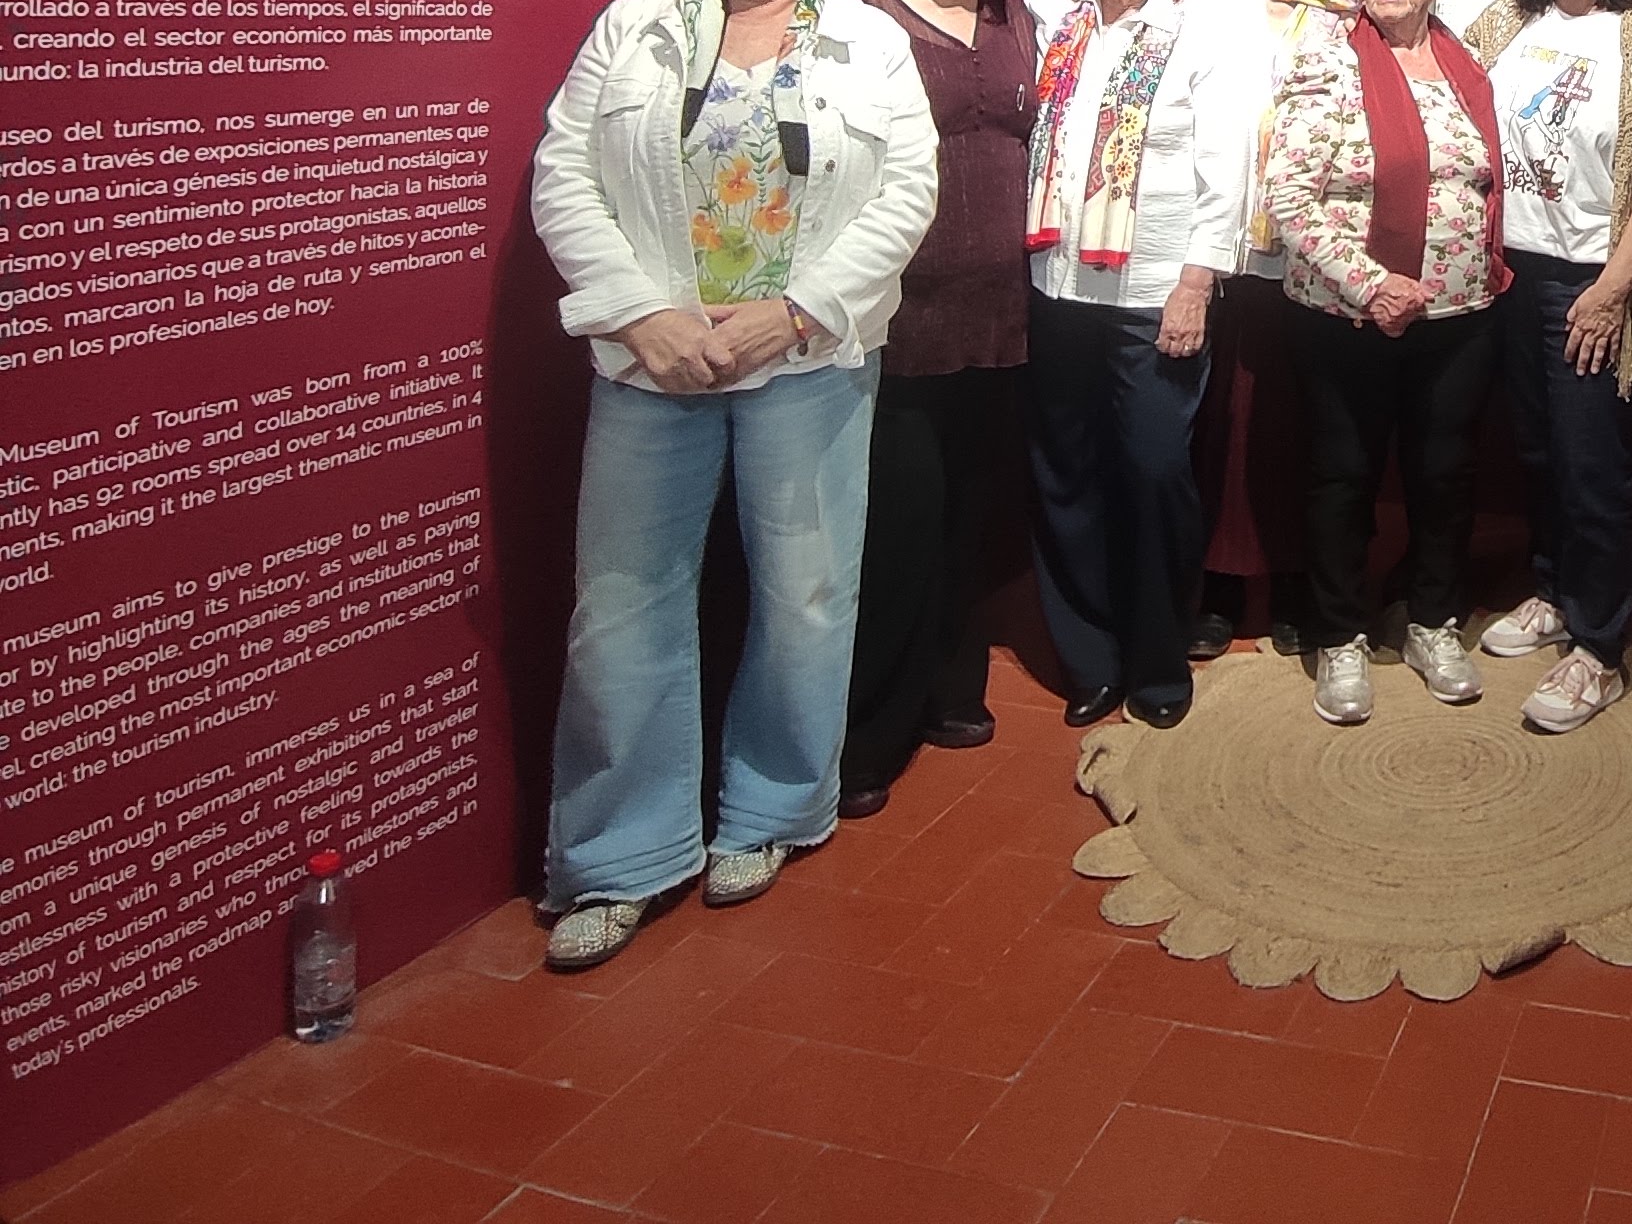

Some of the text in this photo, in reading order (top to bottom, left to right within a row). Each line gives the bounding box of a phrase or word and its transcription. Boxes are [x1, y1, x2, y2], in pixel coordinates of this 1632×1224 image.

[14, 26, 492, 49] creando el sector económico más importante
[19, 221, 64, 240] con
[74, 216, 104, 234] un
[113, 199, 244, 229] sentimiento
[252, 188, 344, 216] protector
[351, 181, 399, 200] hacia
[406, 178, 421, 194] la
[428, 171, 487, 191] historia
[33, 346, 62, 364] en
[70, 339, 104, 357] los
[110, 310, 258, 355] profesionales
[263, 303, 290, 321] de
[295, 297, 334, 316] hoy.
[0, 339, 483, 466] Museum of Tourism was born from a 100%
[3, 488, 480, 654] museum aims to give prestige to the tourism
[88, 820, 166, 866] through
[176, 766, 286, 831] permanent
[295, 720, 392, 772] exhibitions
[400, 698, 433, 724] that
[442, 678, 478, 706] start
